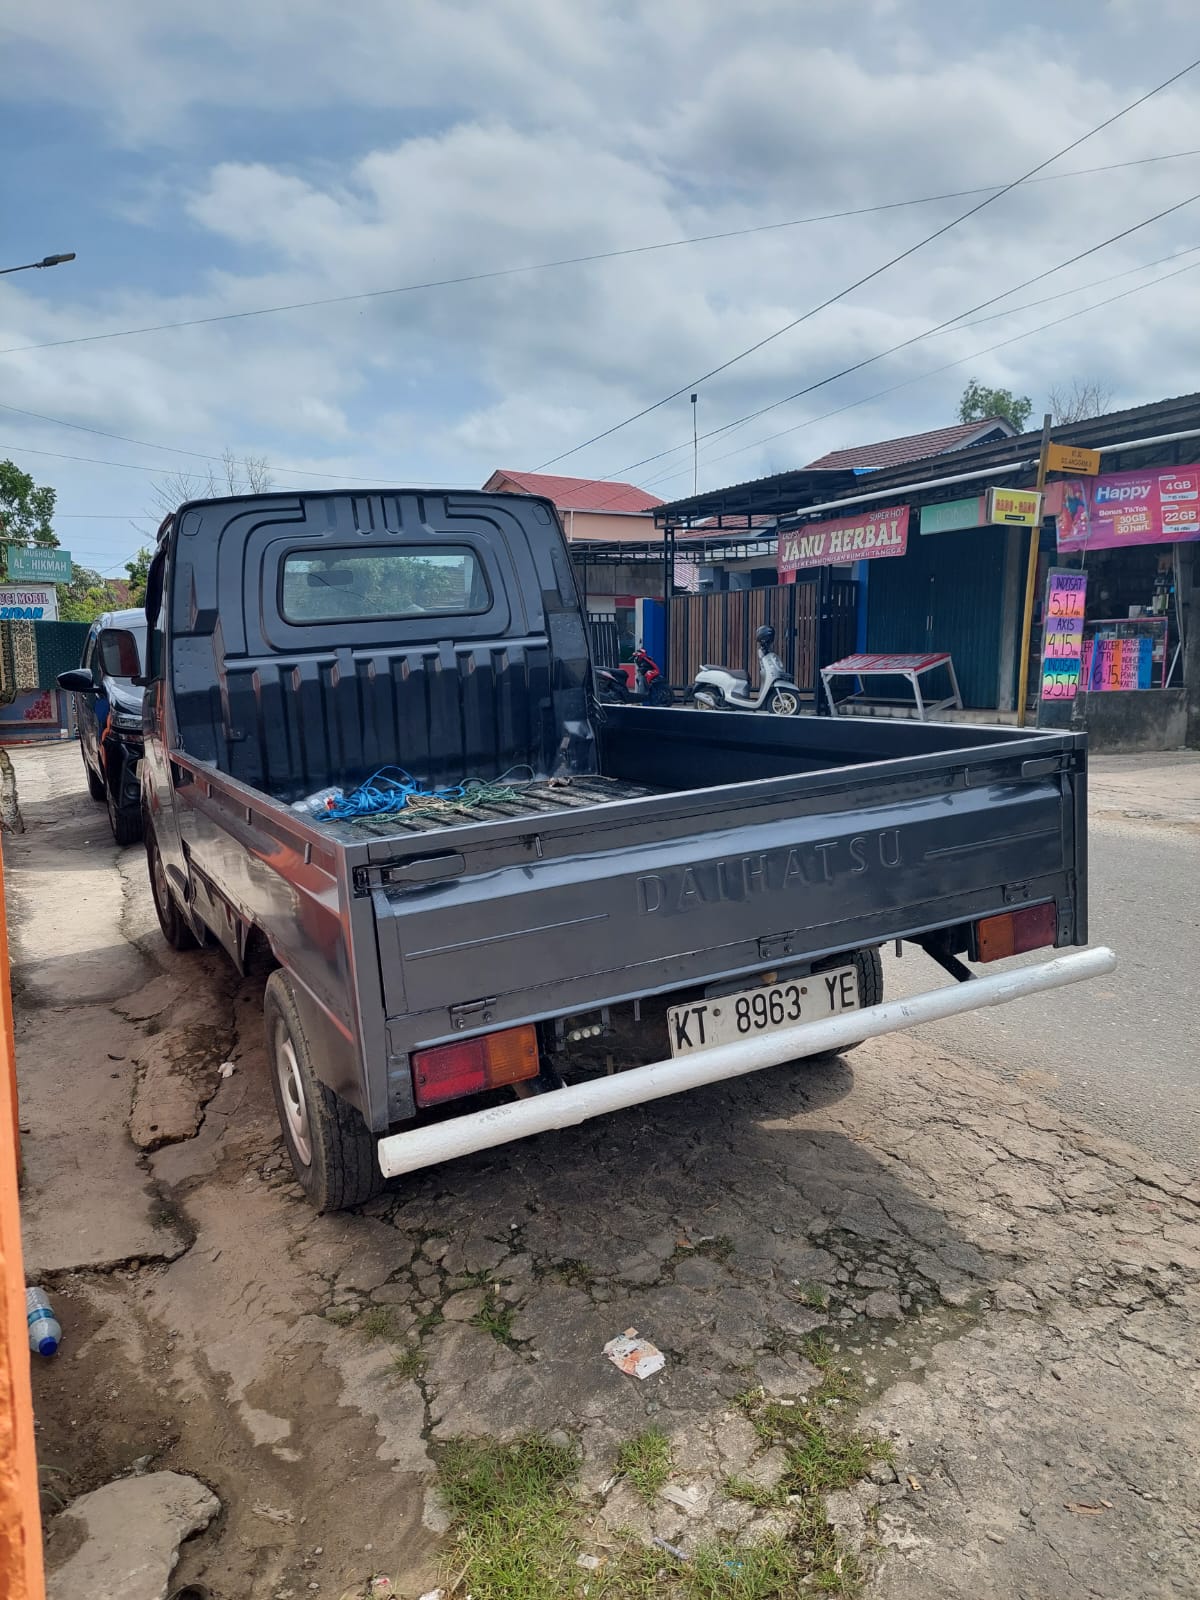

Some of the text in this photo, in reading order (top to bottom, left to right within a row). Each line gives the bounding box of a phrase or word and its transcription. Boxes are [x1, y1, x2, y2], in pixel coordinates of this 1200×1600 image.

[1097, 485, 1152, 501] Happy
[869, 507, 905, 521] SUPER HOT
[1099, 505, 1148, 517] Bonus TikTok
[1117, 525, 1130, 534] 30
[782, 520, 902, 562] JAMU HERBAL
[13, 559, 24, 569] AL
[31, 560, 67, 572] HIKMAH
[17, 592, 49, 605] MOBIL
[0, 607, 44, 620] ZIDAN
[1056, 618, 1075, 631] AXIS
[636, 829, 902, 916] DAIHATSU
[674, 971, 856, 1050] KT 8963 YE
